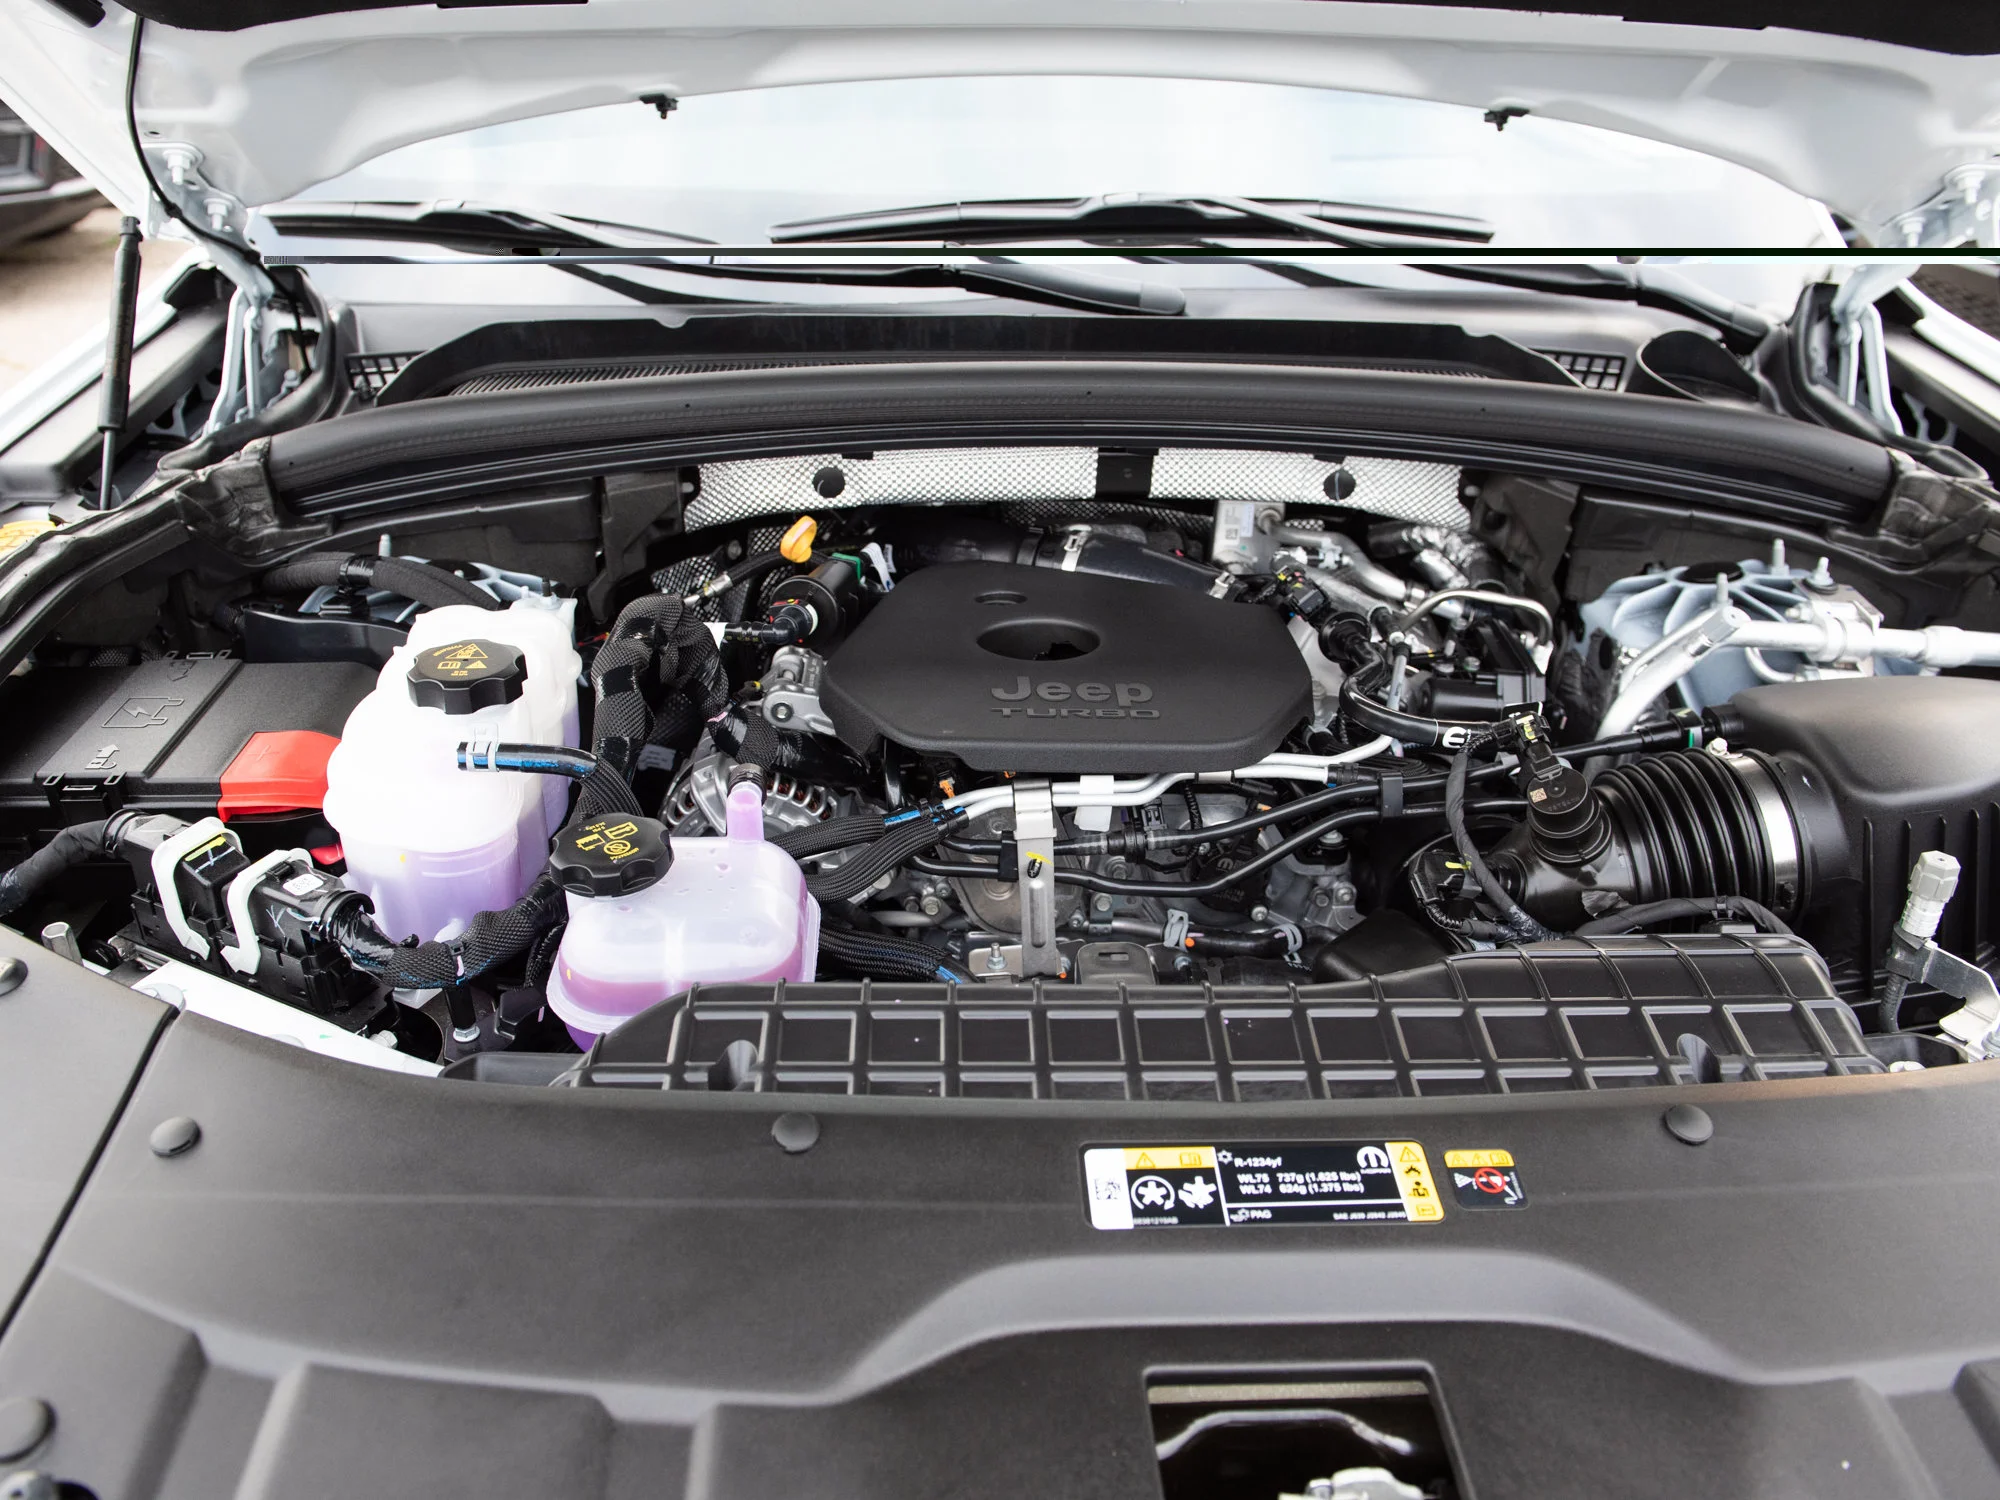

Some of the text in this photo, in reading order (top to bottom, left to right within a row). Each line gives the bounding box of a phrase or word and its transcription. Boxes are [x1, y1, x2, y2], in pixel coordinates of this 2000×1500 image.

[991, 675, 1153, 707] Jeep
[990, 707, 1161, 720] TURBO
[1234, 1156, 1282, 1168] R-1234yf
[1237, 1173, 1270, 1183] WL75
[1276, 1172, 1304, 1184] 737g
[1340, 1171, 1361, 1182] lbs)
[1239, 1182, 1364, 1195] WL74 624g (1.375 lbs)
[1250, 1209, 1272, 1219] PAG
